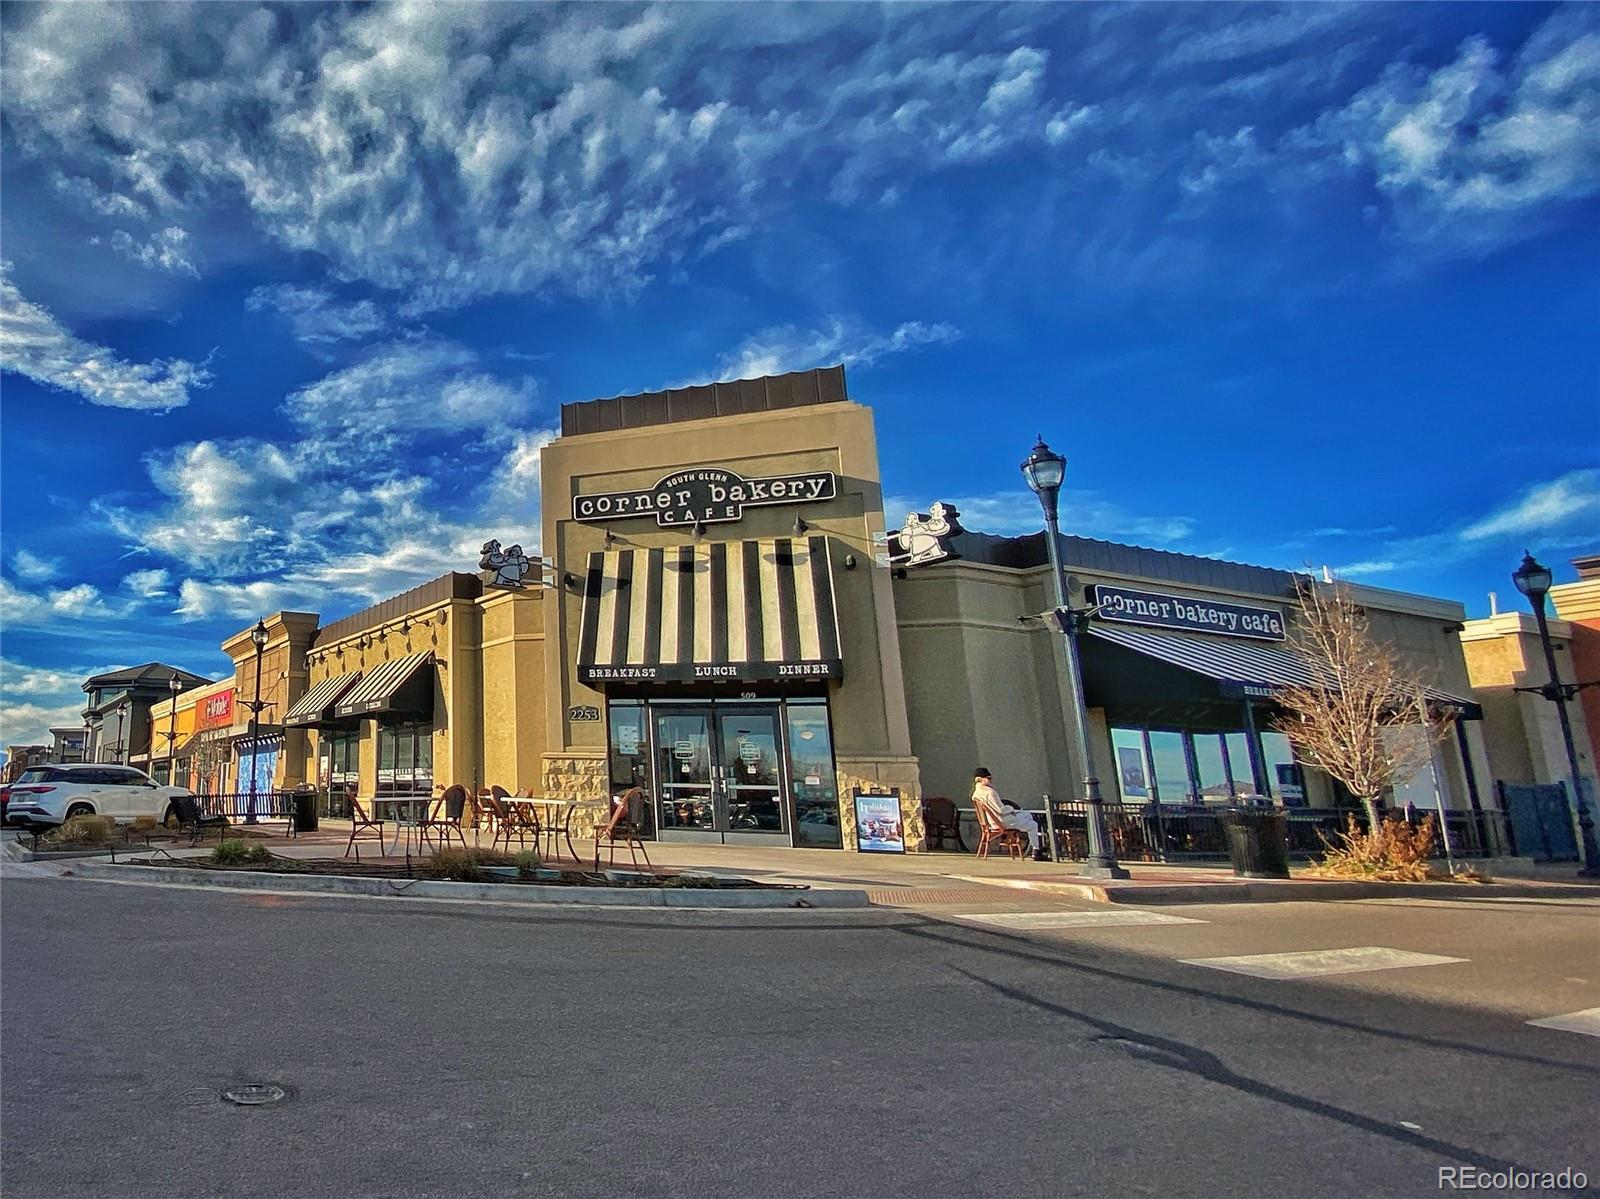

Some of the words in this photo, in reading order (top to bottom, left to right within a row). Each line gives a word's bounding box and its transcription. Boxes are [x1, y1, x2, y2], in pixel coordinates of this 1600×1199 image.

[666, 473, 695, 488] SOUTH
[698, 472, 728, 483] GLENN
[580, 489, 692, 516] corner
[708, 477, 826, 503] bakery
[665, 505, 736, 523] CAFE
[1102, 594, 1171, 619] corner
[1172, 599, 1238, 631] bakery
[1241, 611, 1282, 634] cafe
[588, 668, 656, 679] BREAKFAST
[695, 666, 738, 677] LUNCH
[778, 664, 830, 675] DINNER
[740, 691, 757, 700] 509
[570, 709, 598, 720] 2253
